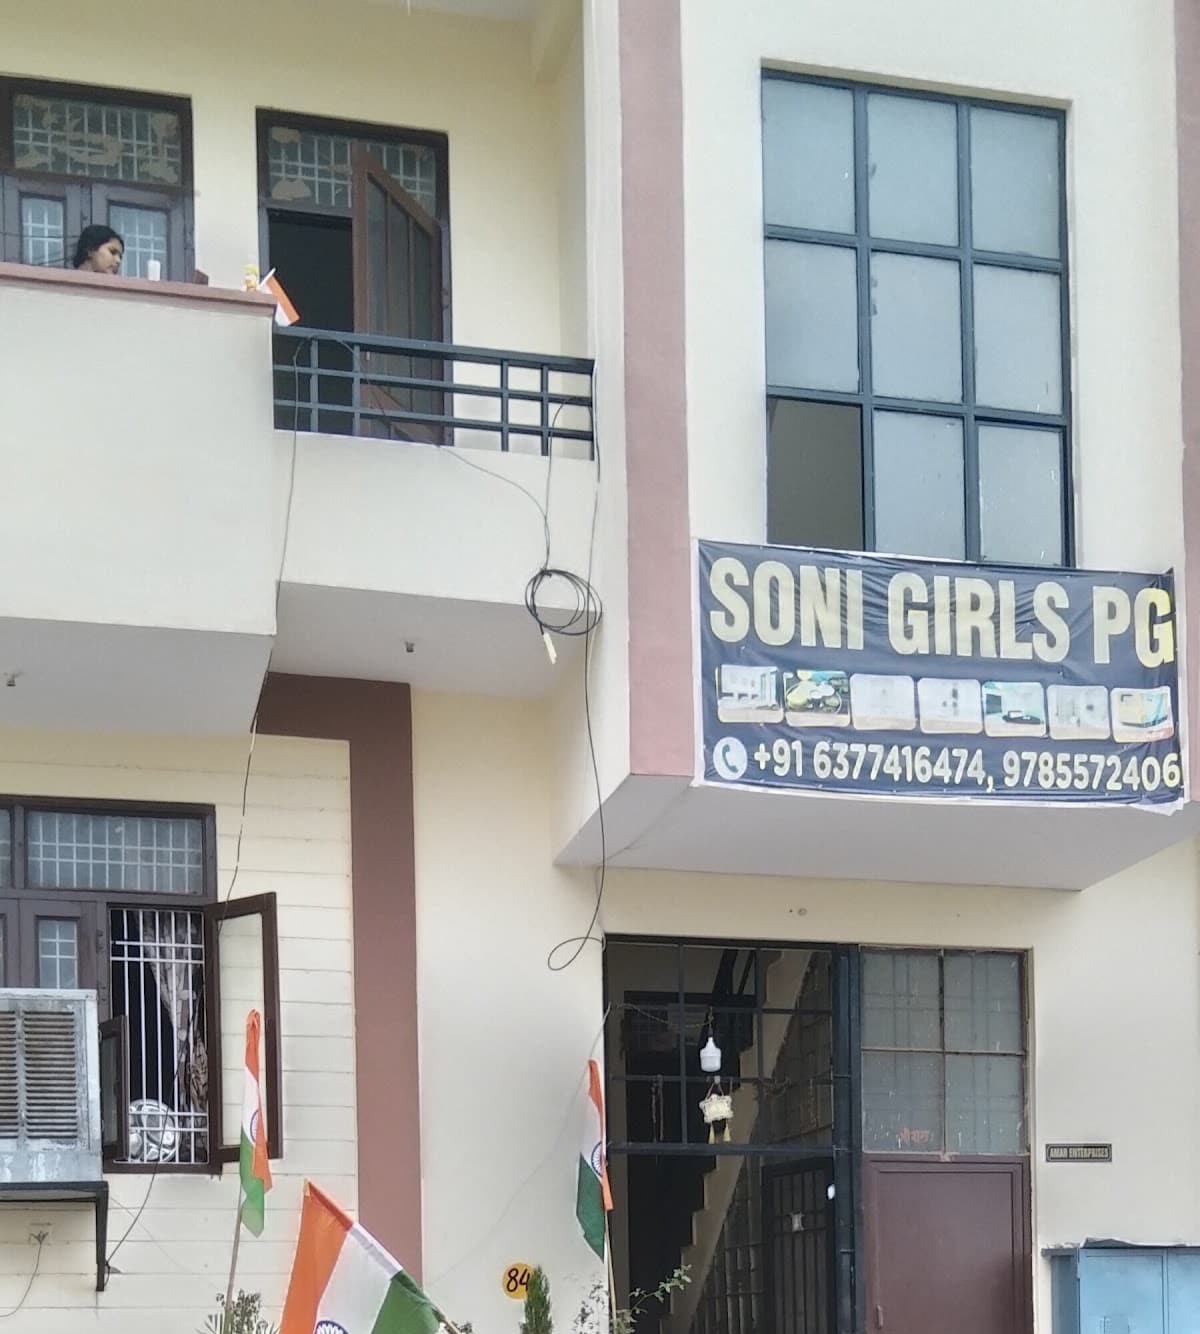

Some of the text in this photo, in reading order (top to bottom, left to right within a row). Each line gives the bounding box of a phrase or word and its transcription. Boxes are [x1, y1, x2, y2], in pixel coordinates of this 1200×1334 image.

[709, 557, 1175, 668] SONI GIRLS PG
[753, 738, 1181, 793] +91 6377416474, 9785572406
[506, 1267, 530, 1293] 84
